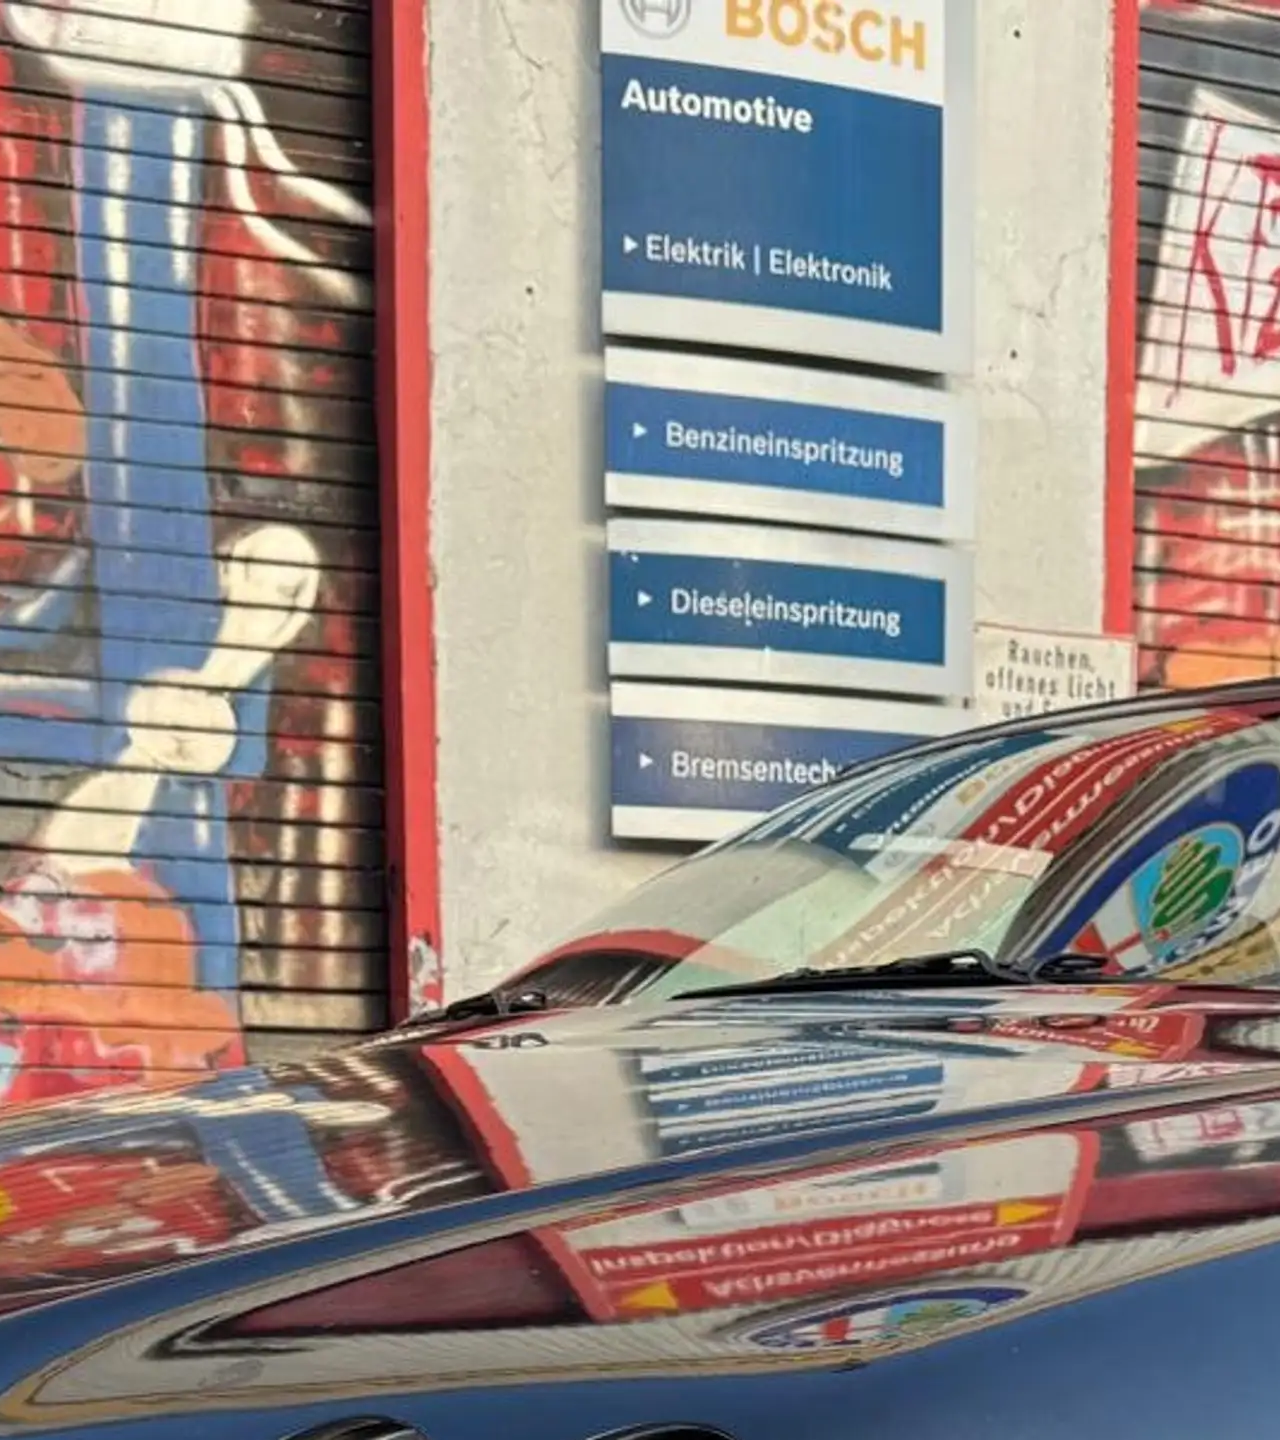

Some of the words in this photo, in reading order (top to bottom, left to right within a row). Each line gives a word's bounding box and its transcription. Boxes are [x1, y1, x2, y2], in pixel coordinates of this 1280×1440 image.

[726, 0, 926, 70] BOSCH
[621, 78, 814, 133] Automotive
[646, 234, 746, 270] Elektrik
[769, 248, 894, 291] Elektronik
[665, 420, 904, 477] Benzineinspritzung
[671, 588, 902, 637] Dieseleinspritzung
[985, 667, 1059, 695] offenes
[671, 750, 842, 785] Bremsentech
